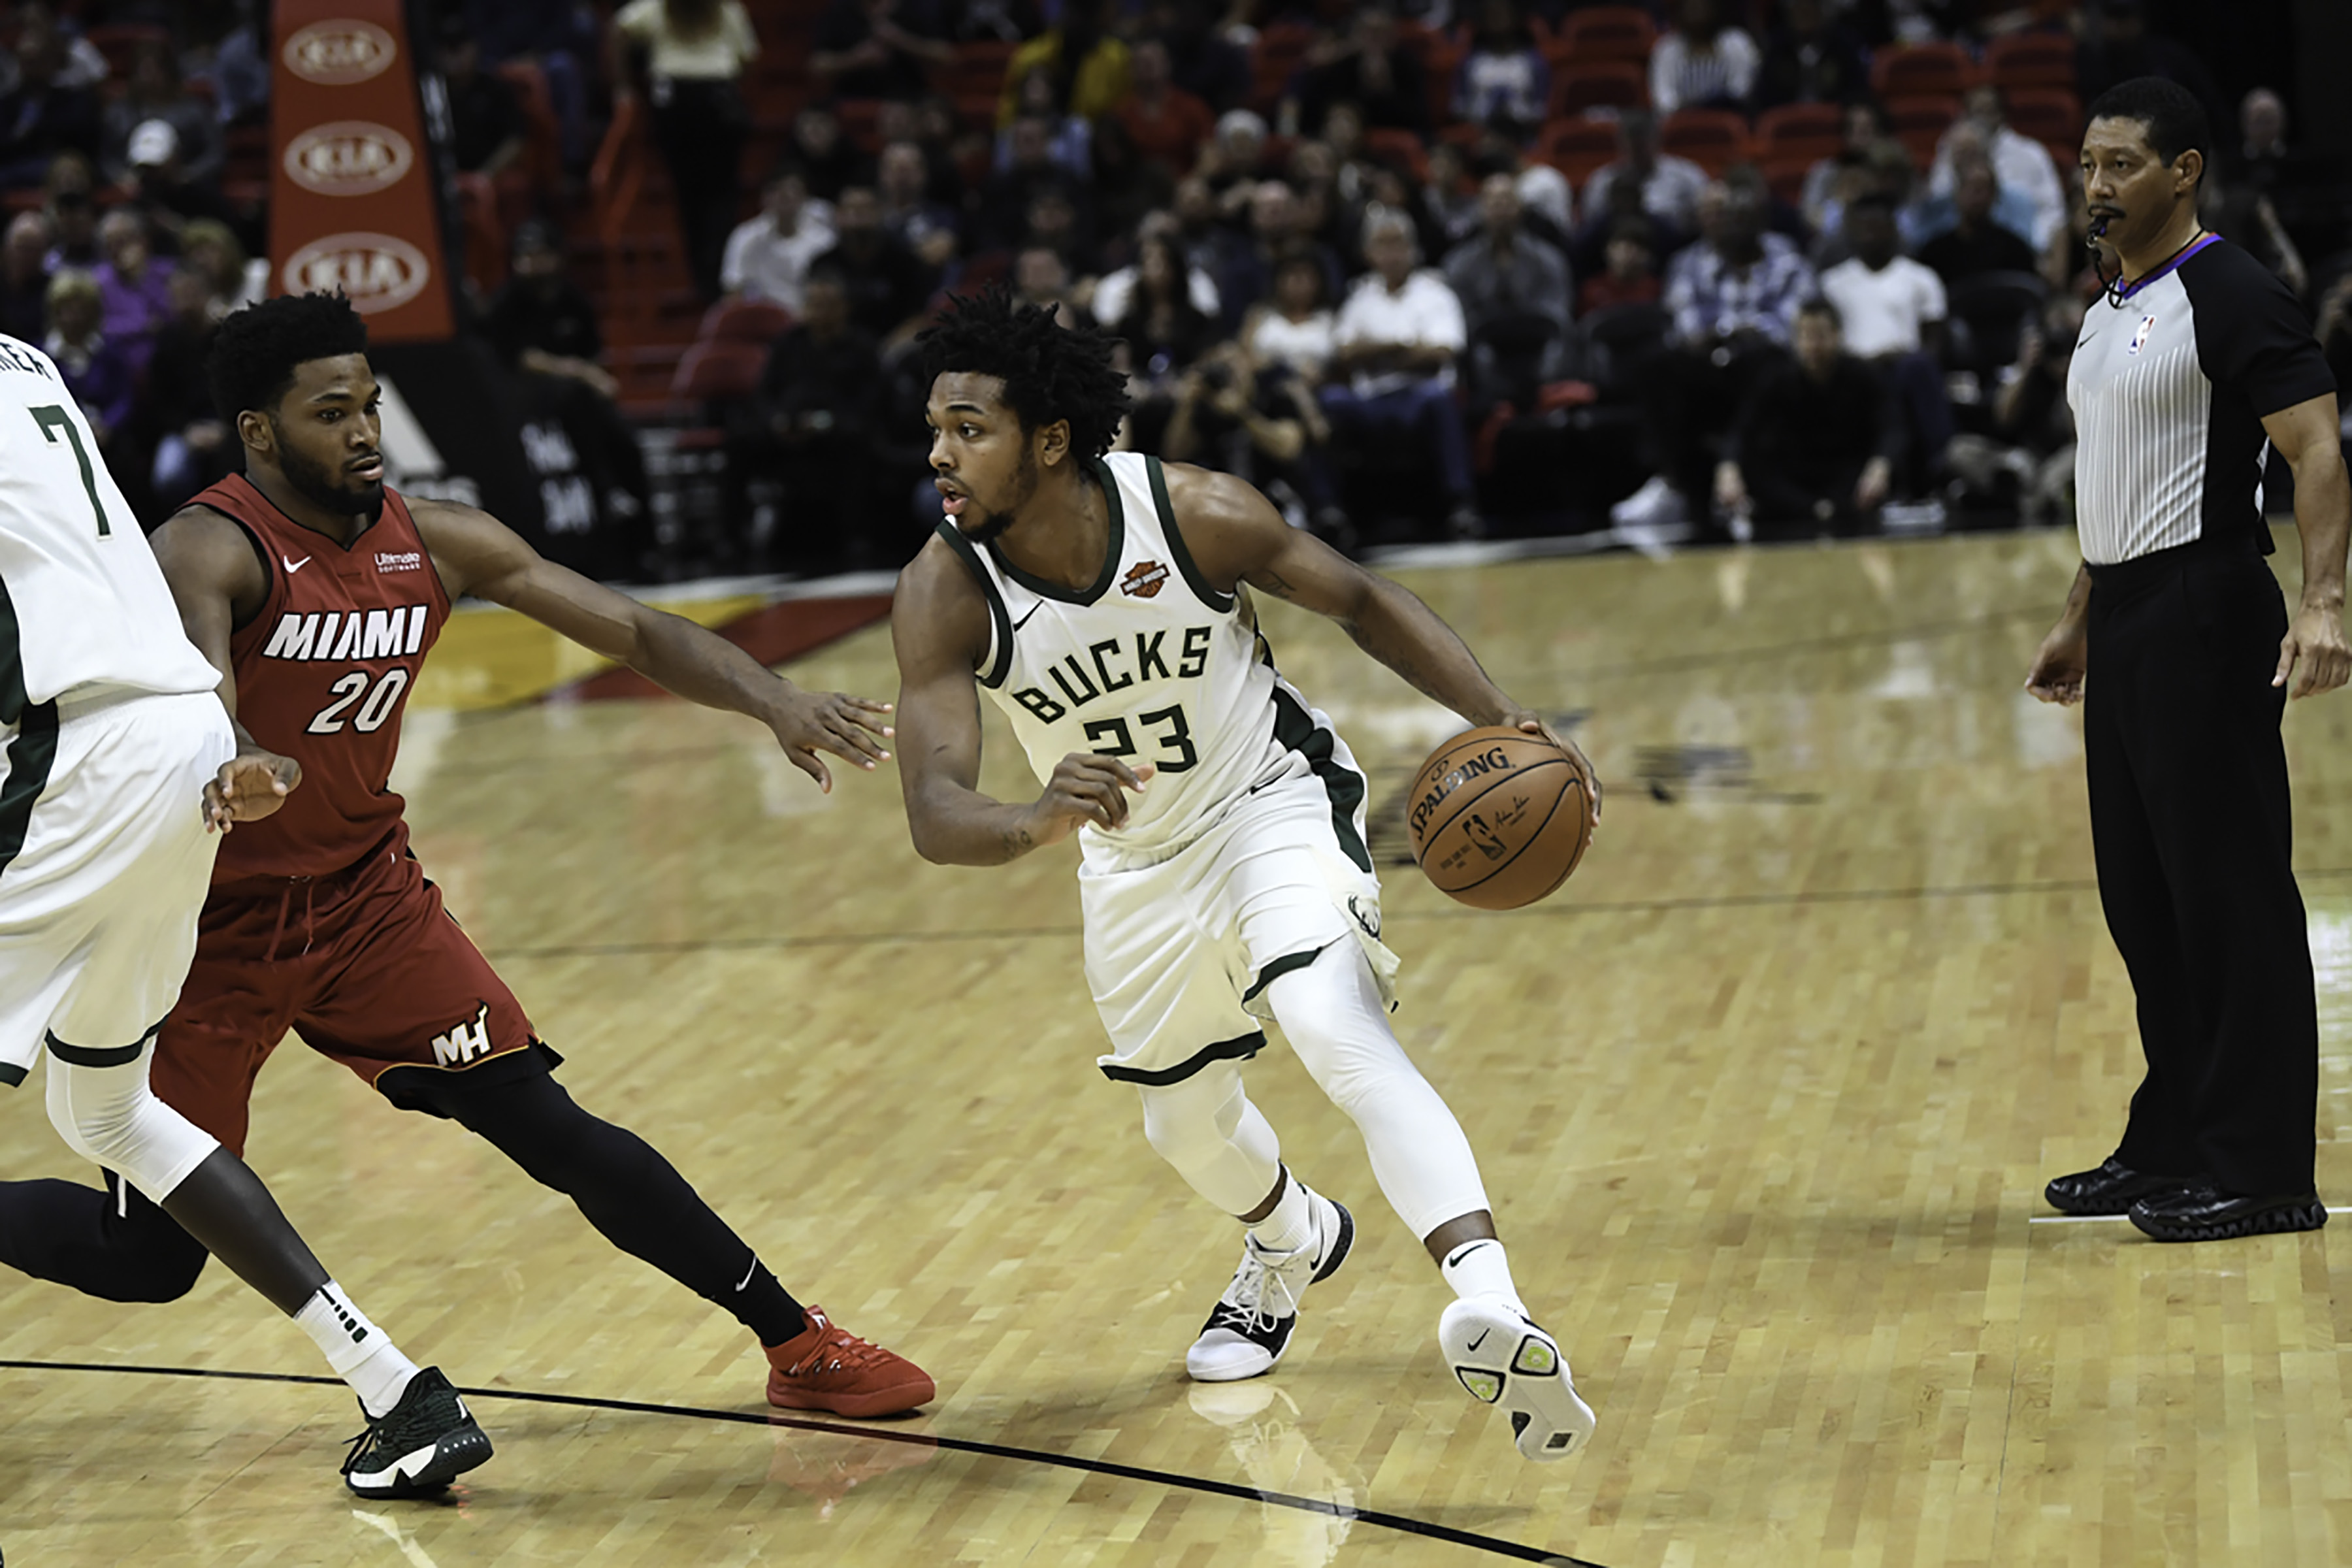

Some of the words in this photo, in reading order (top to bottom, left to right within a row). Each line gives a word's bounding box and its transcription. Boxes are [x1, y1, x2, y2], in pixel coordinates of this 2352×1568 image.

[27, 404, 111, 536] 7
[263, 604, 429, 661] MIAMI
[306, 668, 409, 733] 20
[1011, 625, 1212, 725] BUCKS
[1082, 703, 1198, 773] 23
[1410, 747, 1511, 841] SPALDING
